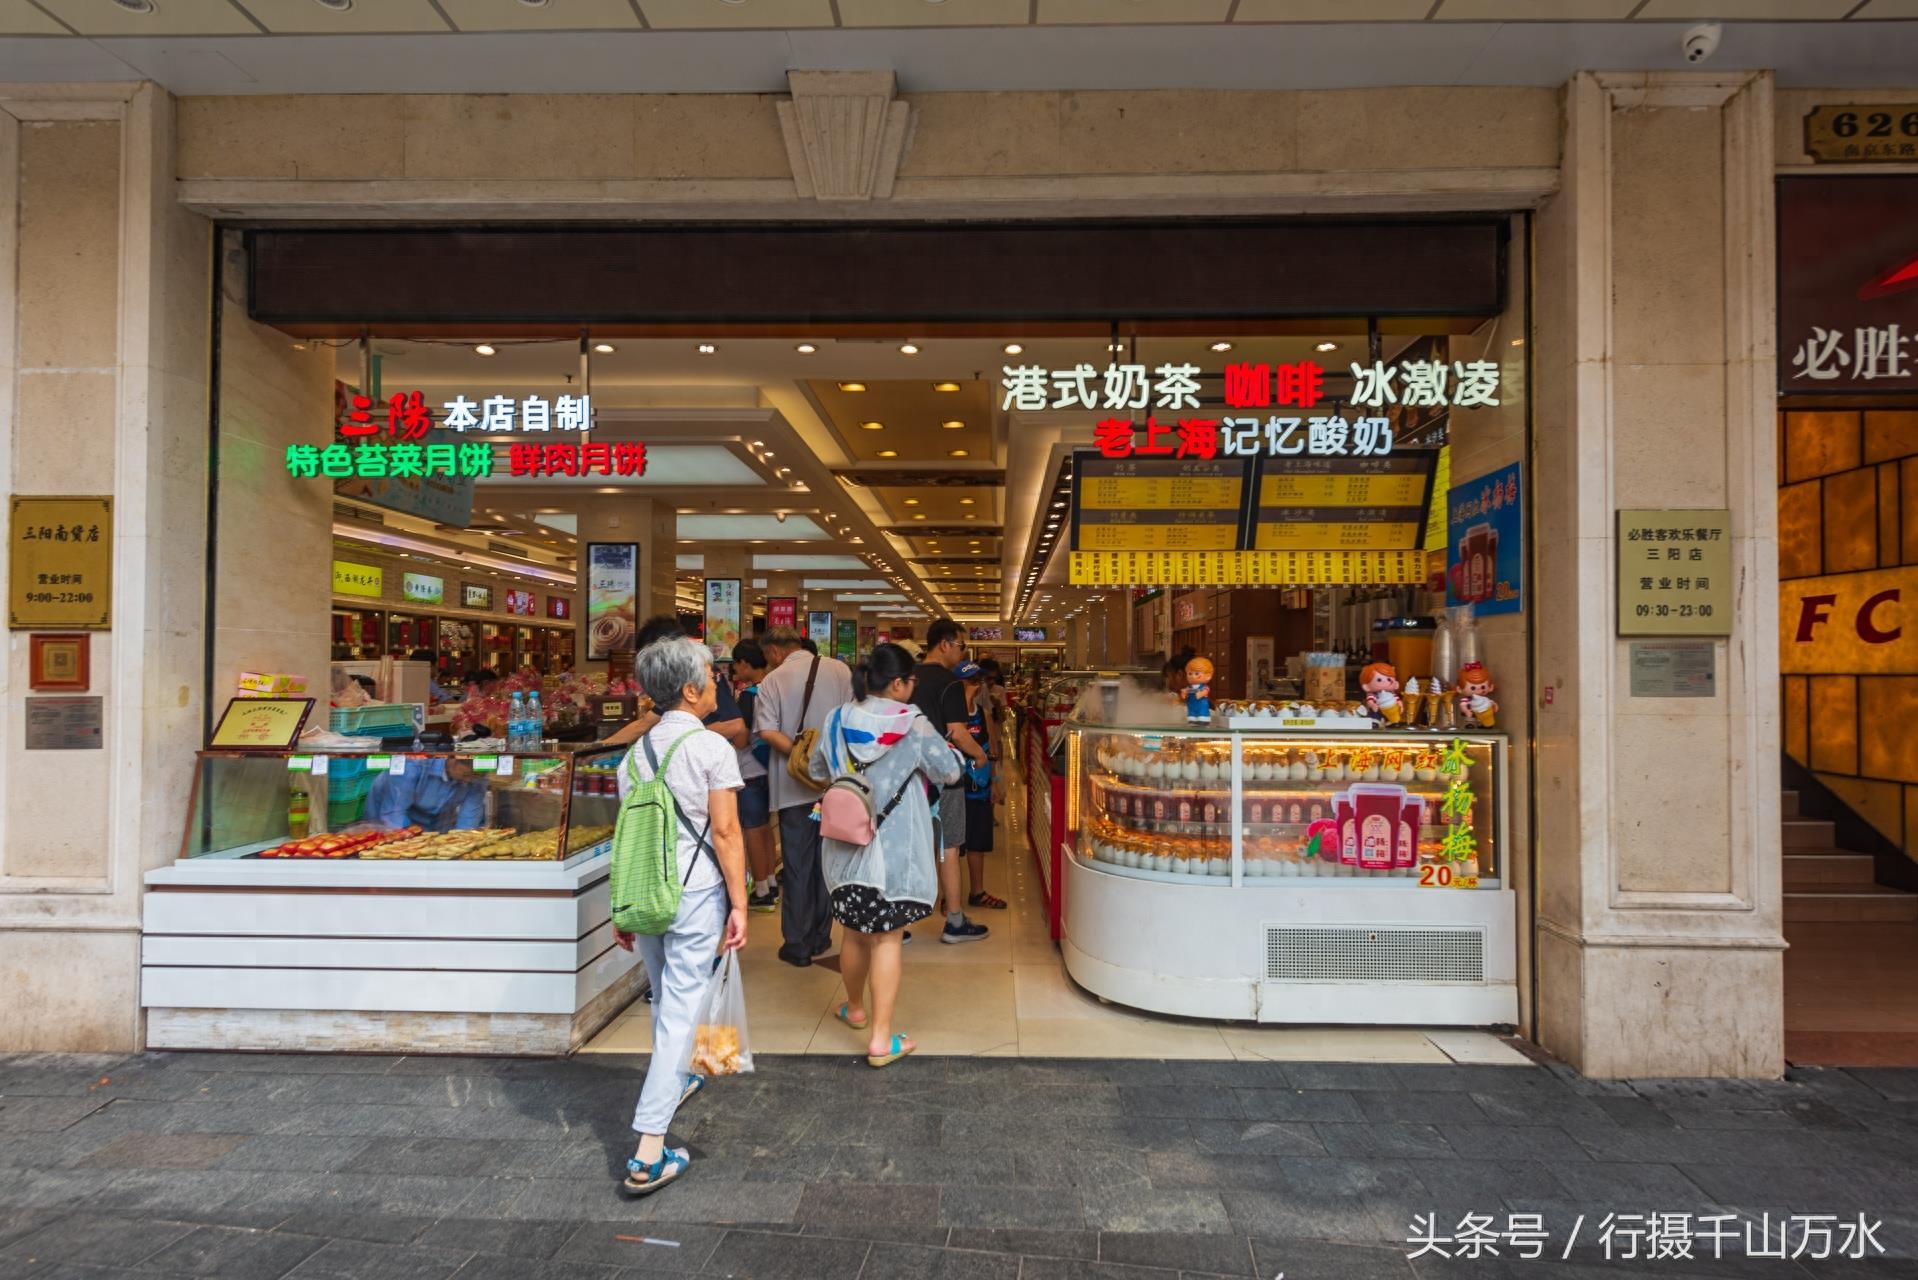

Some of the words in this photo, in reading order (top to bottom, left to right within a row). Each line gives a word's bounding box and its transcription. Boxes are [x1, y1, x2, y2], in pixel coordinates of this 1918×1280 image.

[1832, 112, 1918, 137] 626
[1791, 323, 1918, 380] 必胜
[1001, 361, 1202, 411] 港式奶茶
[1224, 360, 1325, 409] 咖啡
[1350, 359, 1501, 408] 冰激凌
[339, 389, 433, 440] 三陽
[443, 395, 591, 434] 本店自制
[1093, 414, 1394, 459] 老上海记忆酸奶
[285, 442, 494, 479] 特色苔菜月饼
[508, 441, 648, 477] 鲜肉月饼
[22, 525, 101, 543] 三阳南货店
[1628, 528, 1723, 542] 必胜客欢乐餐厅
[1647, 548, 1703, 561] 三阳店
[37, 573, 84, 585] 营业时间
[1639, 577, 1710, 591] 营业时间
[25, 592, 94, 603] 9:00-22:00
[1635, 604, 1713, 617] 09:30-23:00
[1317, 748, 1437, 772] 上海网红
[1439, 737, 1478, 863] 冰杨梅
